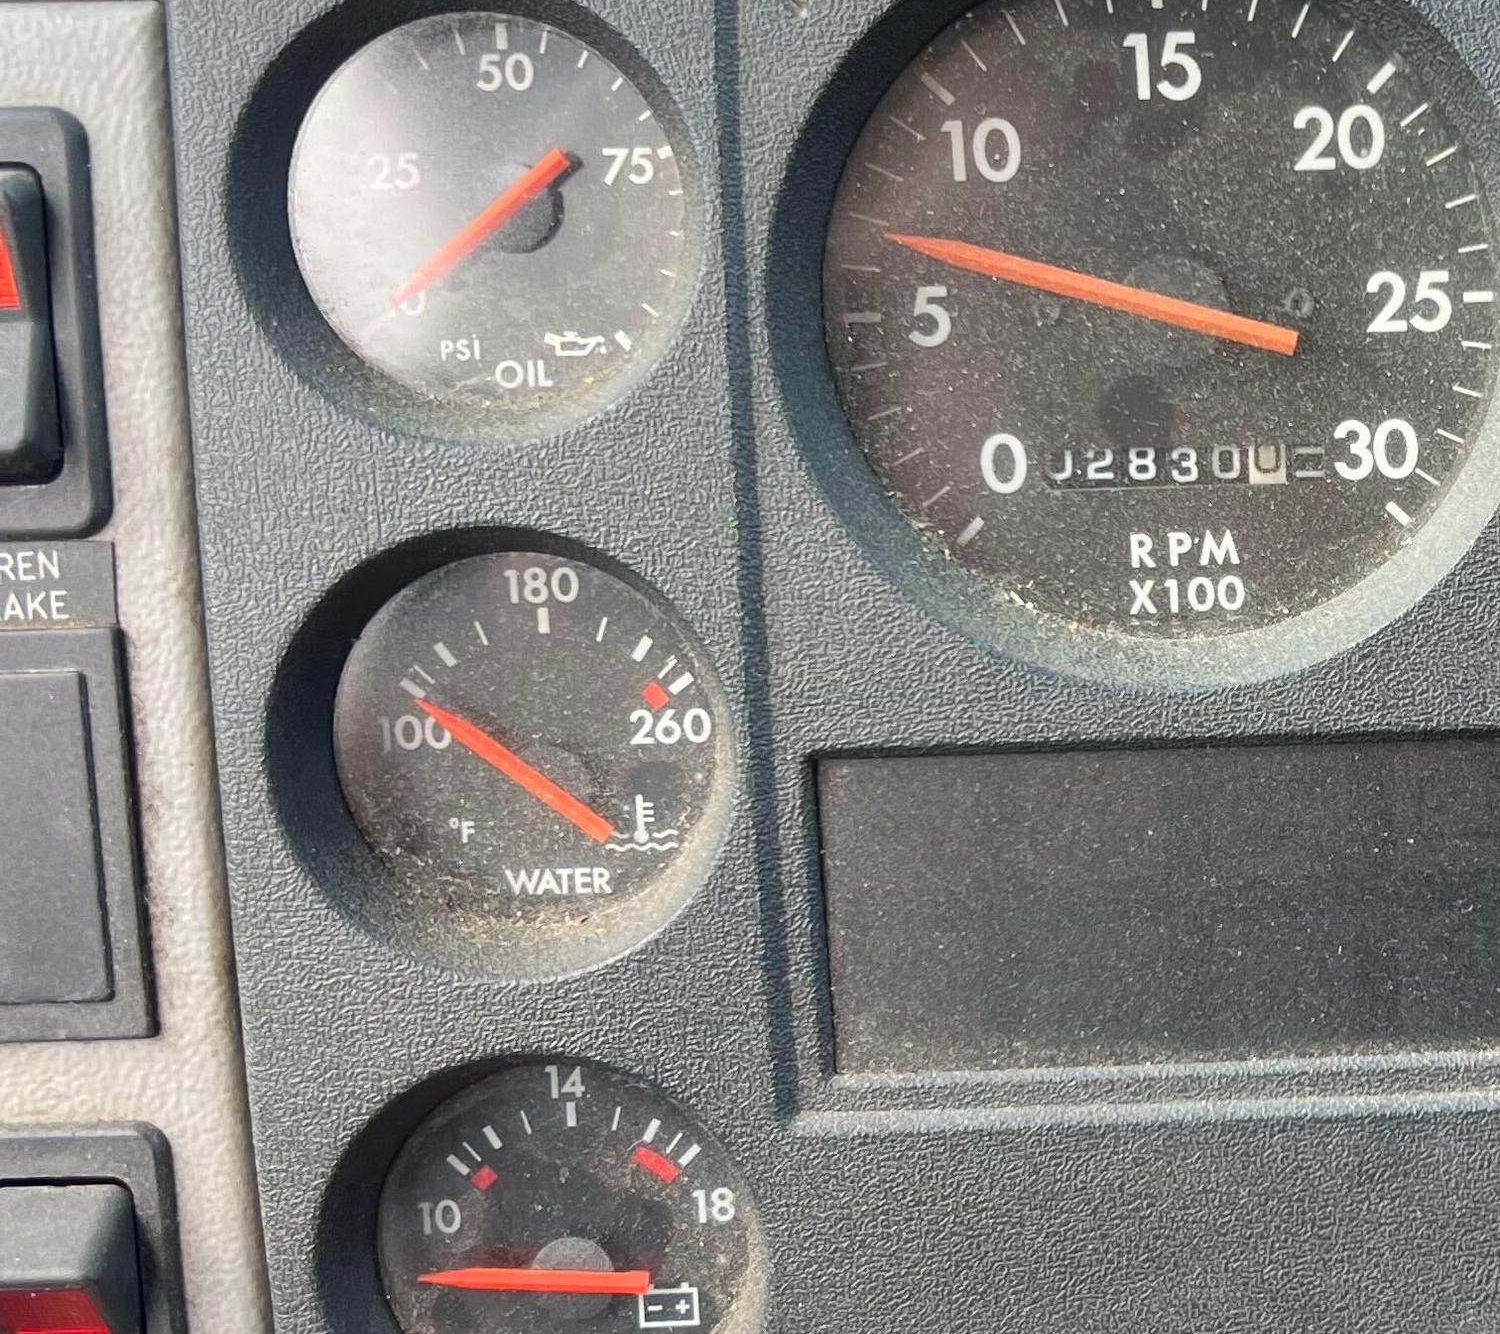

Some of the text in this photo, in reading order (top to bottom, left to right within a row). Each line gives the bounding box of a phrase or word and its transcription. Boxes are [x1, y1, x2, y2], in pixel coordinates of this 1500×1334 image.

[477, 53, 534, 91] 50
[1122, 31, 1202, 101] 15
[940, 118, 1021, 182] 10
[1293, 104, 1385, 170] 20
[367, 153, 421, 190] 25
[602, 147, 654, 185] 75
[908, 286, 953, 347] 5
[1366, 270, 1452, 333] 25
[440, 335, 480, 361] PSI
[495, 360, 552, 388] OIL
[980, 434, 1027, 493] 0
[1333, 419, 1418, 481] 30
[1130, 530, 1240, 567] RPM
[503, 567, 579, 604] 180
[1129, 576, 1245, 615] X100
[380, 715, 452, 751] 100
[629, 708, 712, 745] 260
[504, 867, 612, 895] WATER
[545, 1065, 585, 1099] 14
[417, 1199, 462, 1235] 10
[692, 1187, 736, 1223] 18
